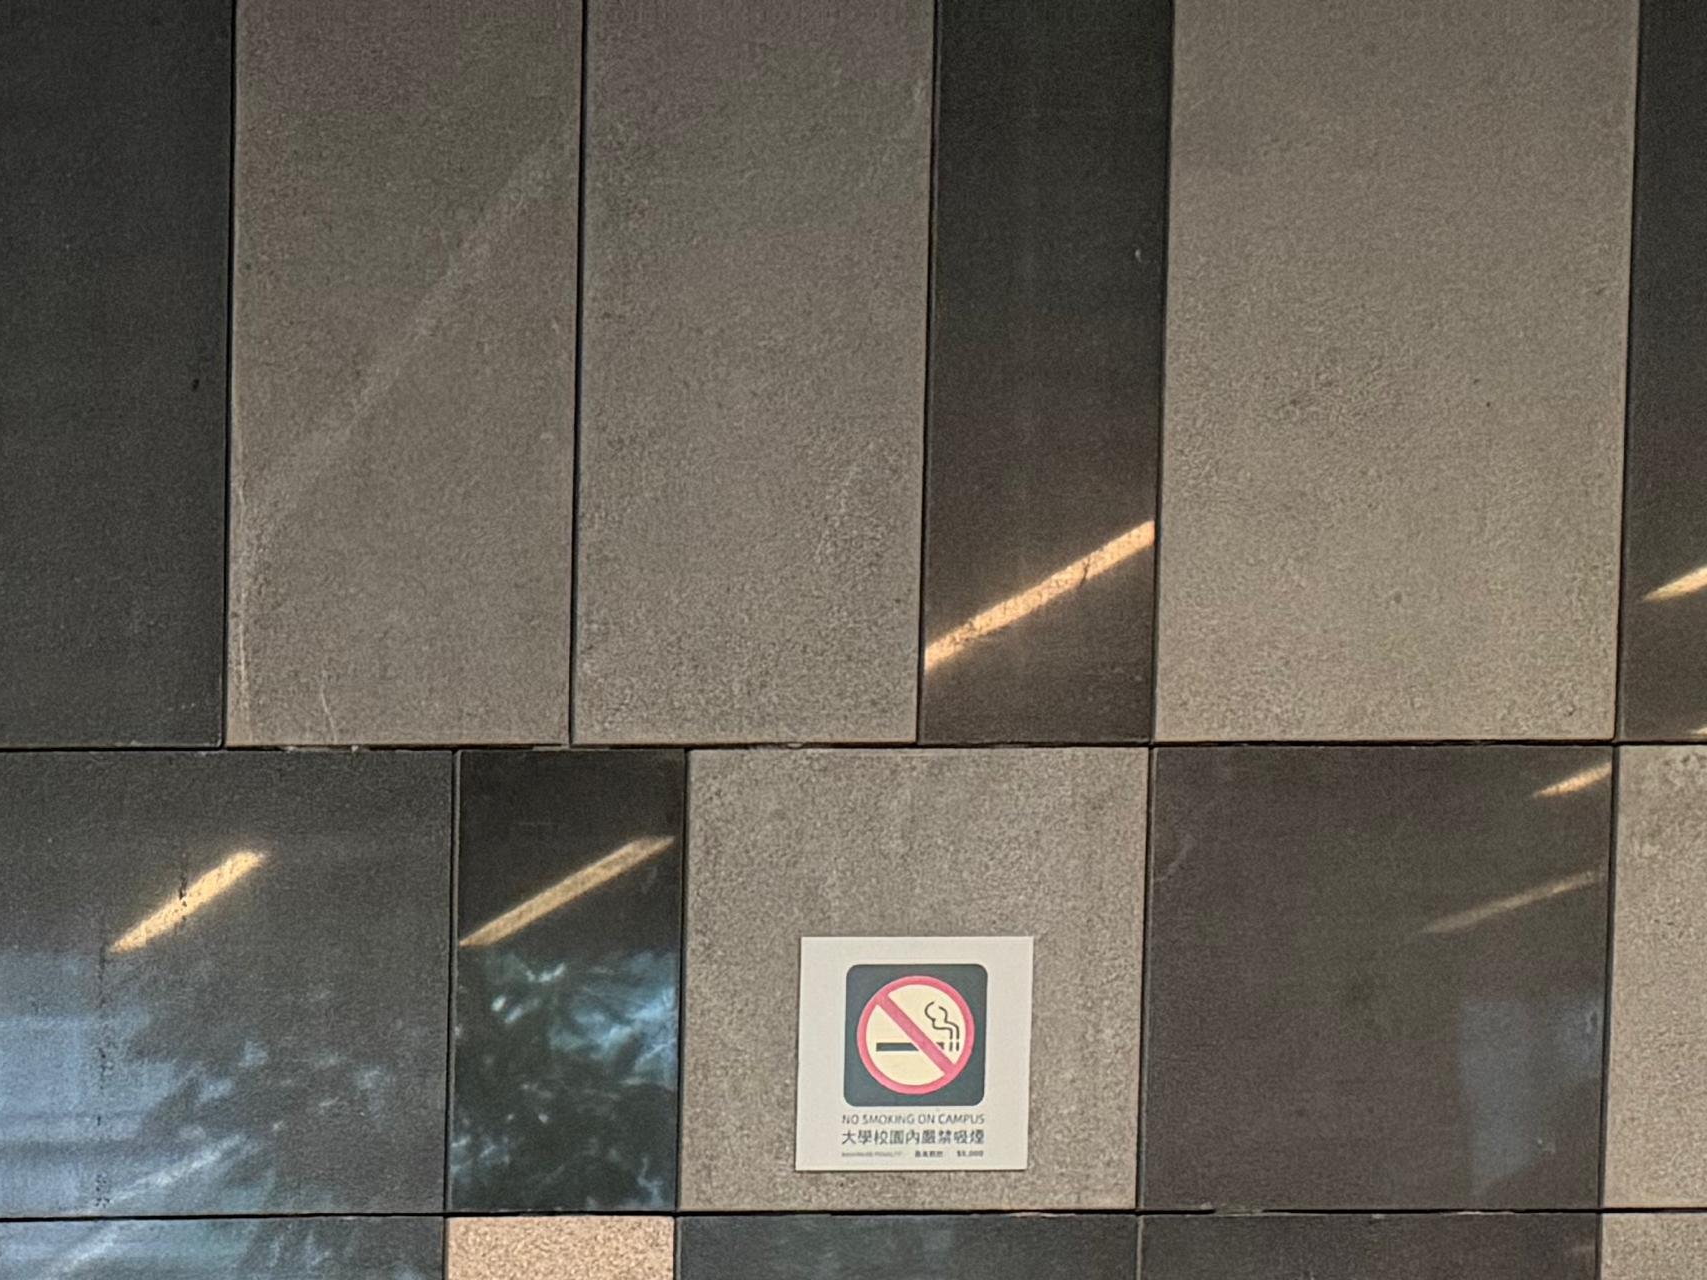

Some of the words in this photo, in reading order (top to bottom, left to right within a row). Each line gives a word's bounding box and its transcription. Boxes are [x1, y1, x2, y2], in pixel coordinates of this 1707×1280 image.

[842, 1114, 859, 1125] NO
[862, 1114, 915, 1125] SMOKING
[917, 1114, 935, 1125] ON
[938, 1114, 985, 1125] CAMPUS
